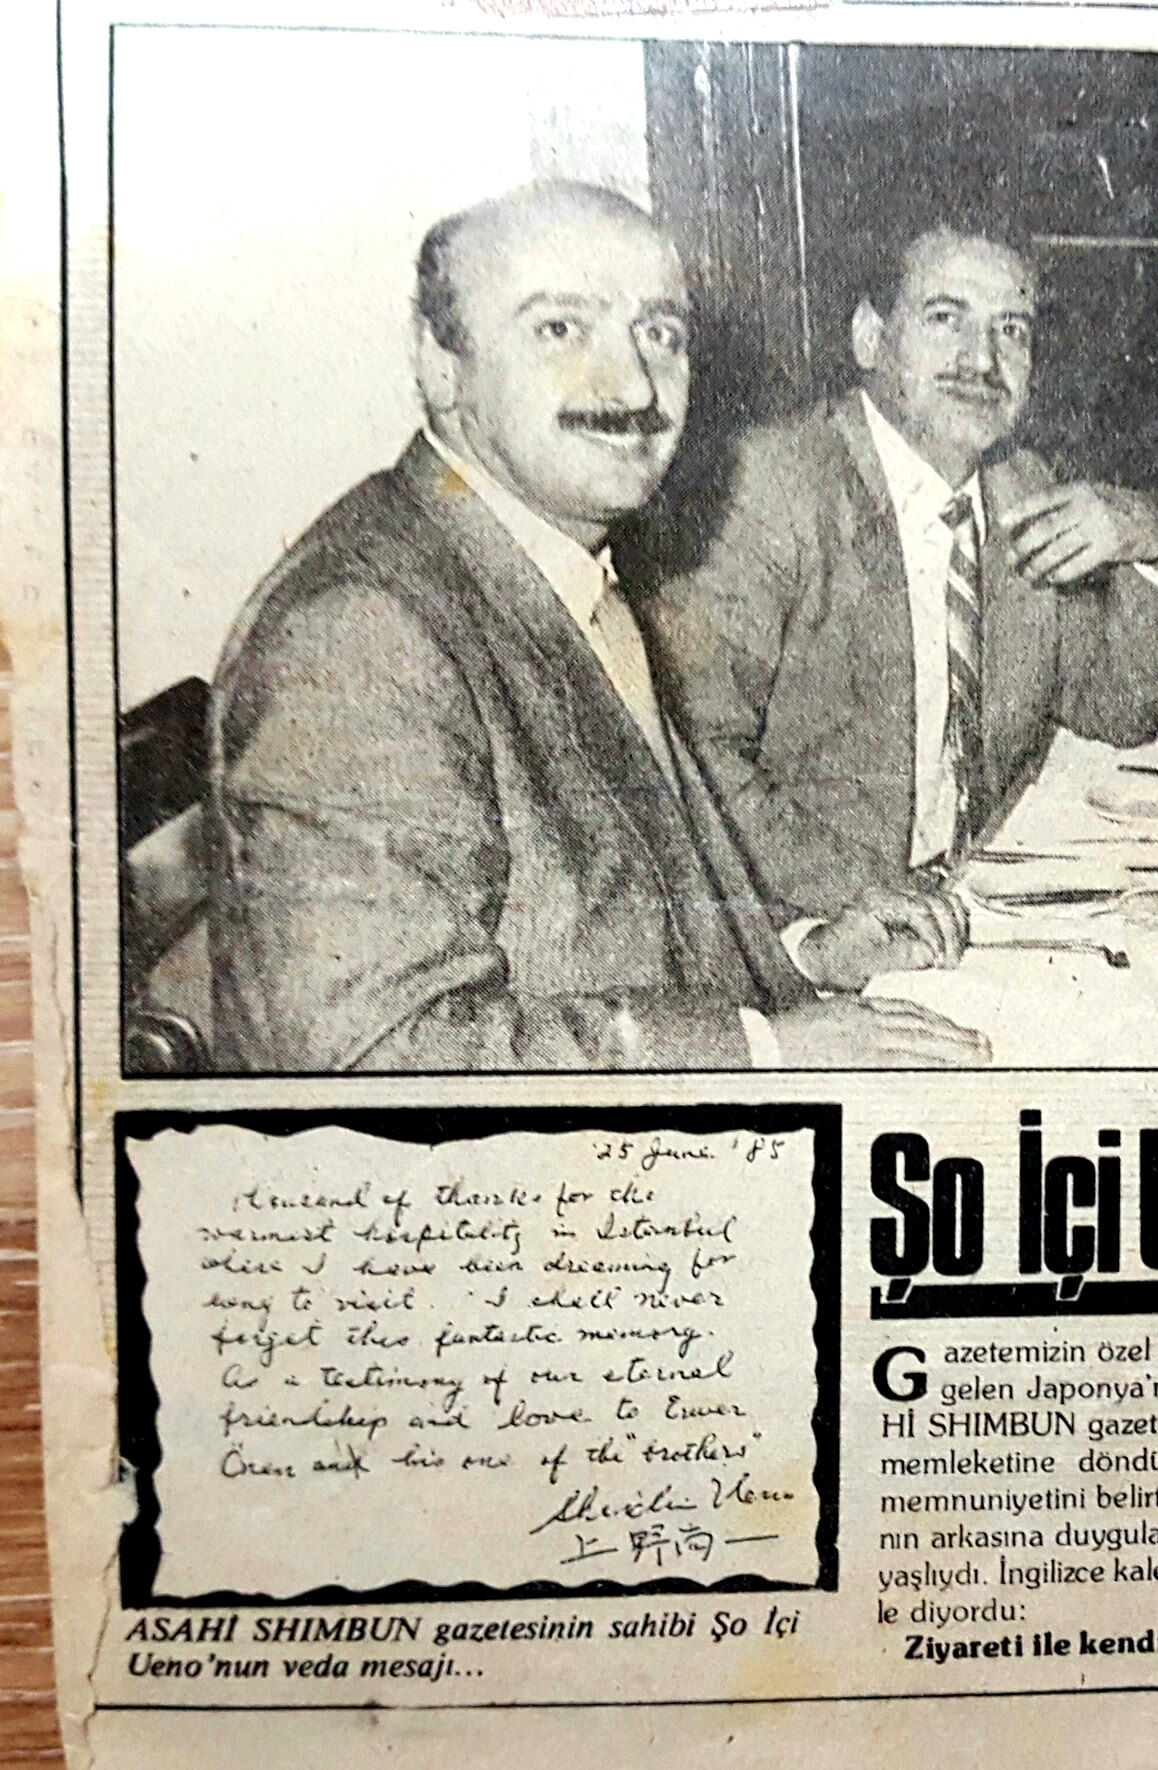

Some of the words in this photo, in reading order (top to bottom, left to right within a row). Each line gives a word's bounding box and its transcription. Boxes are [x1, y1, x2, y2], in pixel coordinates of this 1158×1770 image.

[871, 1132, 983, 1302] Şo
[1018, 1109, 1122, 1298] İçi
[1098, 1336, 1151, 1362] özel
[941, 1375, 1014, 1406] gelen
[882, 1408, 915, 1438] Hİ
[928, 1411, 1075, 1438] SHIMBUN
[881, 1448, 1055, 1475] memleketine
[881, 1488, 1085, 1516] memnuniyetini
[880, 1533, 919, 1550] nın
[931, 1523, 1043, 1549] arkasına
[879, 1561, 987, 1593] yaşlıydı.
[1000, 1555, 1105, 1590] İngilizce
[124, 1613, 239, 1643] ASAHİ
[252, 1617, 422, 1642] SHIMBUN
[433, 1615, 594, 1647] gazetesinin
[608, 1612, 697, 1639] sahibi
[710, 1611, 748, 1643] Şo
[764, 1605, 800, 1639] İçi
[878, 1598, 898, 1625] le
[910, 1597, 1025, 1629] diyordu:
[904, 1634, 1023, 1665] Ziyareti
[1033, 1631, 1071, 1657] ile
[128, 1652, 270, 1679] Ueno'nun
[283, 1653, 349, 1679] veda
[360, 1652, 483, 1683] mesajı...
